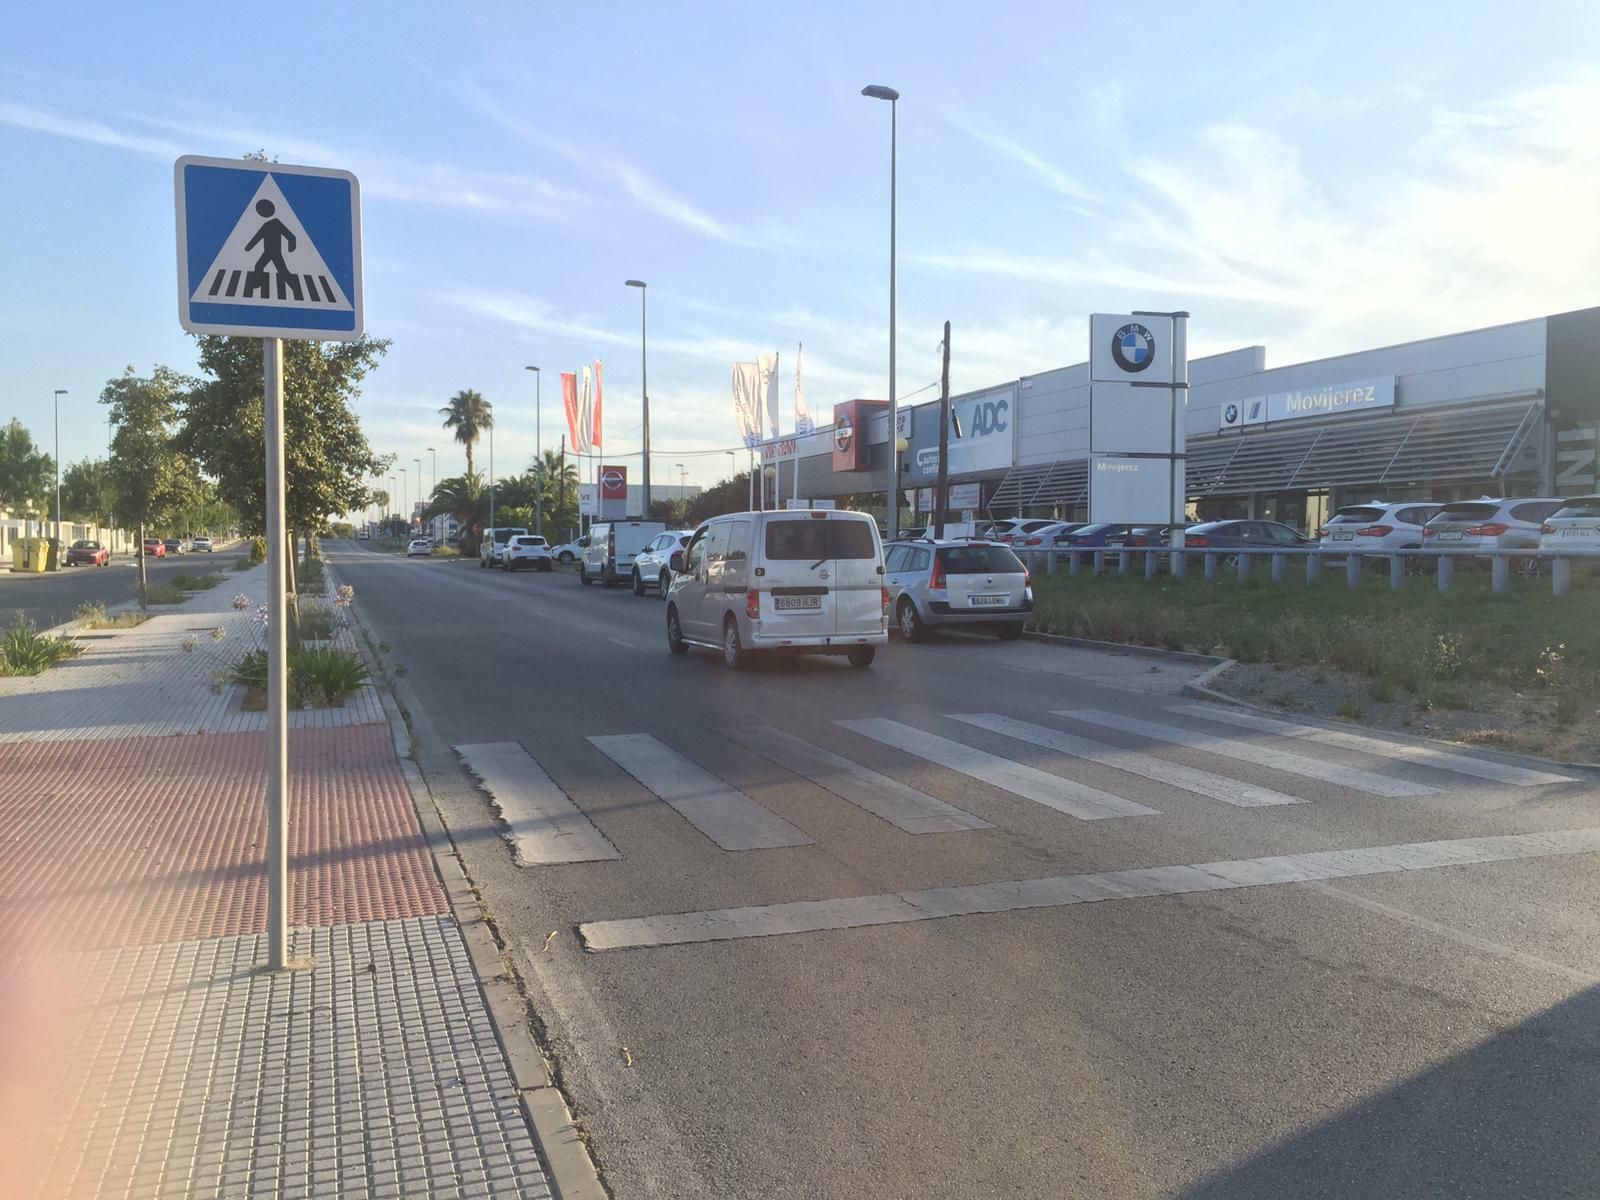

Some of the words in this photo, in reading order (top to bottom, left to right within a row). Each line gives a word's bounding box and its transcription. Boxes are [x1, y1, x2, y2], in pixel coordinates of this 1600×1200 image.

[1286, 385, 1376, 412] Movijerez
[970, 400, 1009, 438] ADC
[1096, 463, 1139, 473] Movijerez
